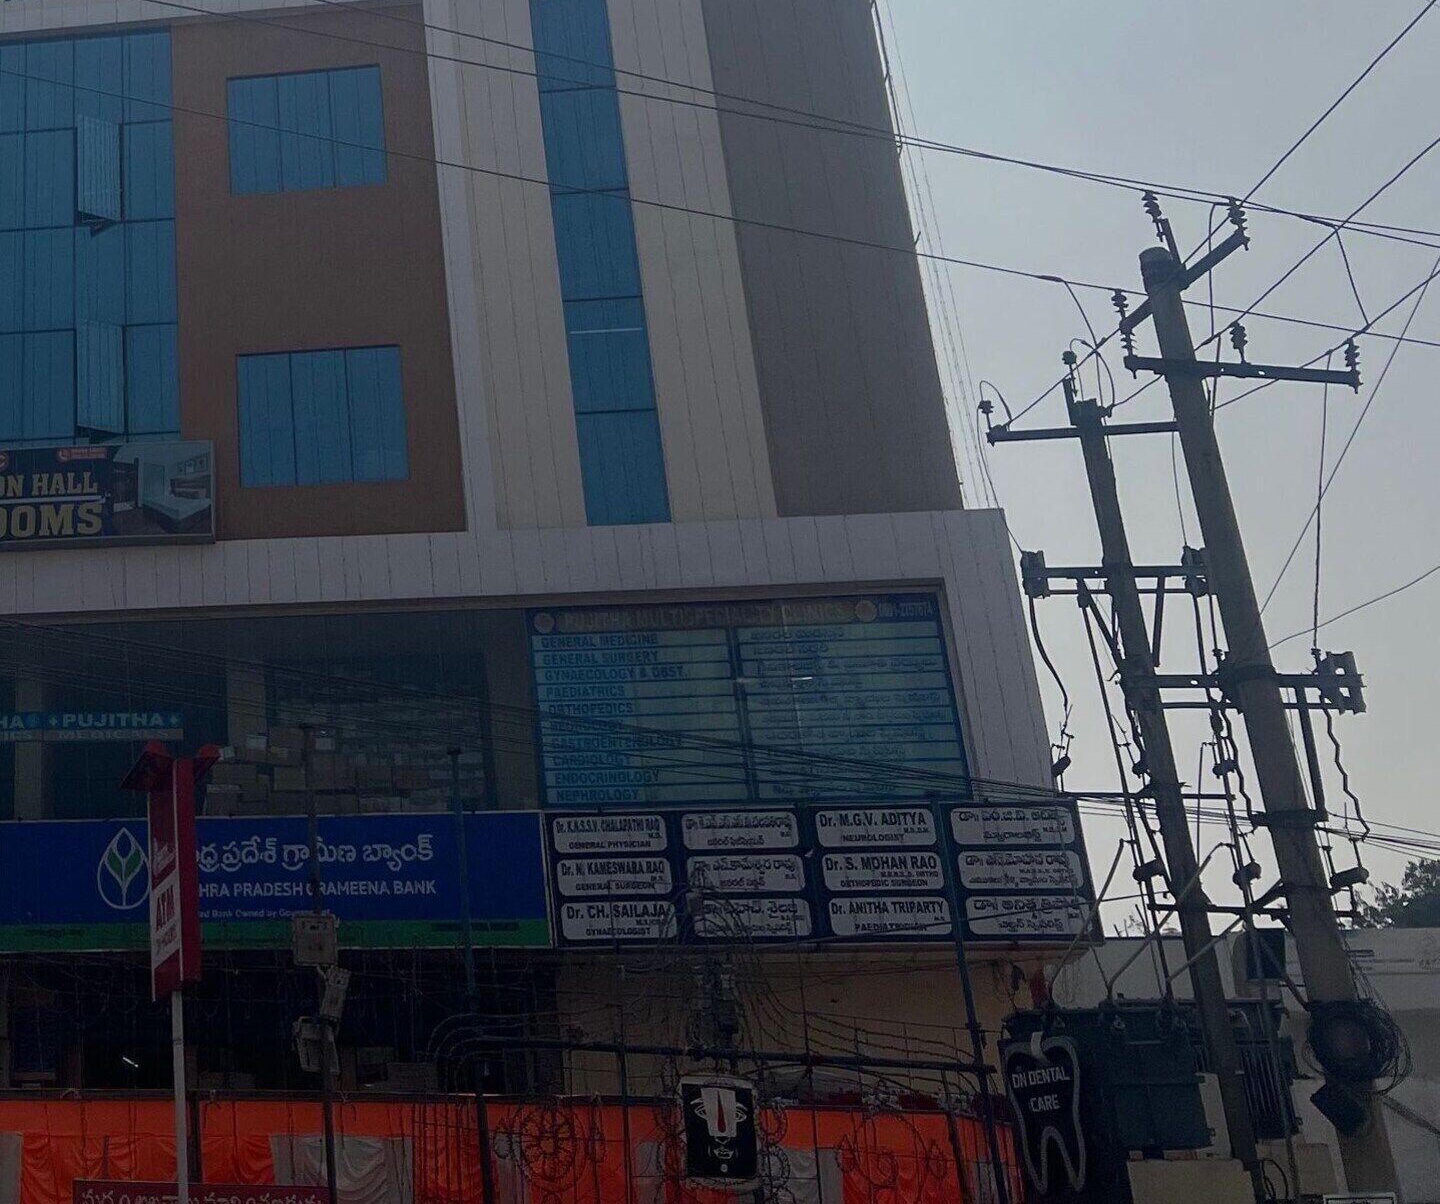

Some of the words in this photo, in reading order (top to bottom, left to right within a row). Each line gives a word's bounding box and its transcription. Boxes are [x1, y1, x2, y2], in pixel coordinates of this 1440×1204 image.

[31, 471, 99, 496] HALL
[540, 636, 596, 648] GENERAL
[600, 634, 659, 646] MEDICINE
[543, 653, 598, 665] GENERAL
[601, 651, 659, 663] SURGERY
[545, 668, 635, 681] GYNAECOLOGY
[546, 685, 625, 698] PAEDIATRICS
[548, 702, 633, 715] ORTHOPEDICS
[62, 712, 165, 727] PUJITHA
[556, 789, 639, 802] NEPHROLOGY
[820, 814, 837, 827] Dr.
[839, 813, 878, 826] M.G.V.
[881, 812, 926, 825] ADITYA
[607, 840, 651, 848] PHYSICIAN
[362, 834, 434, 872] బ్యాంక్
[561, 862, 574, 876] Dr.
[587, 861, 644, 875] KAMESWARA
[646, 861, 665, 874] RAO
[825, 858, 842, 870] Dr.
[845, 857, 858, 870] S.
[860, 856, 907, 870] MOHAN
[910, 855, 937, 869] RAO
[233, 882, 303, 898] PRADESH
[393, 879, 438, 894] BANK
[567, 905, 584, 919] Dr.
[587, 905, 609, 918] CH.
[613, 904, 666, 918] SAILAJA
[831, 902, 846, 915] Dr.
[849, 901, 889, 914] ANITHA
[891, 900, 944, 914] TRIPARTY
[1028, 1066, 1071, 1086] DENTAL
[1030, 1094, 1061, 1112] CARE
